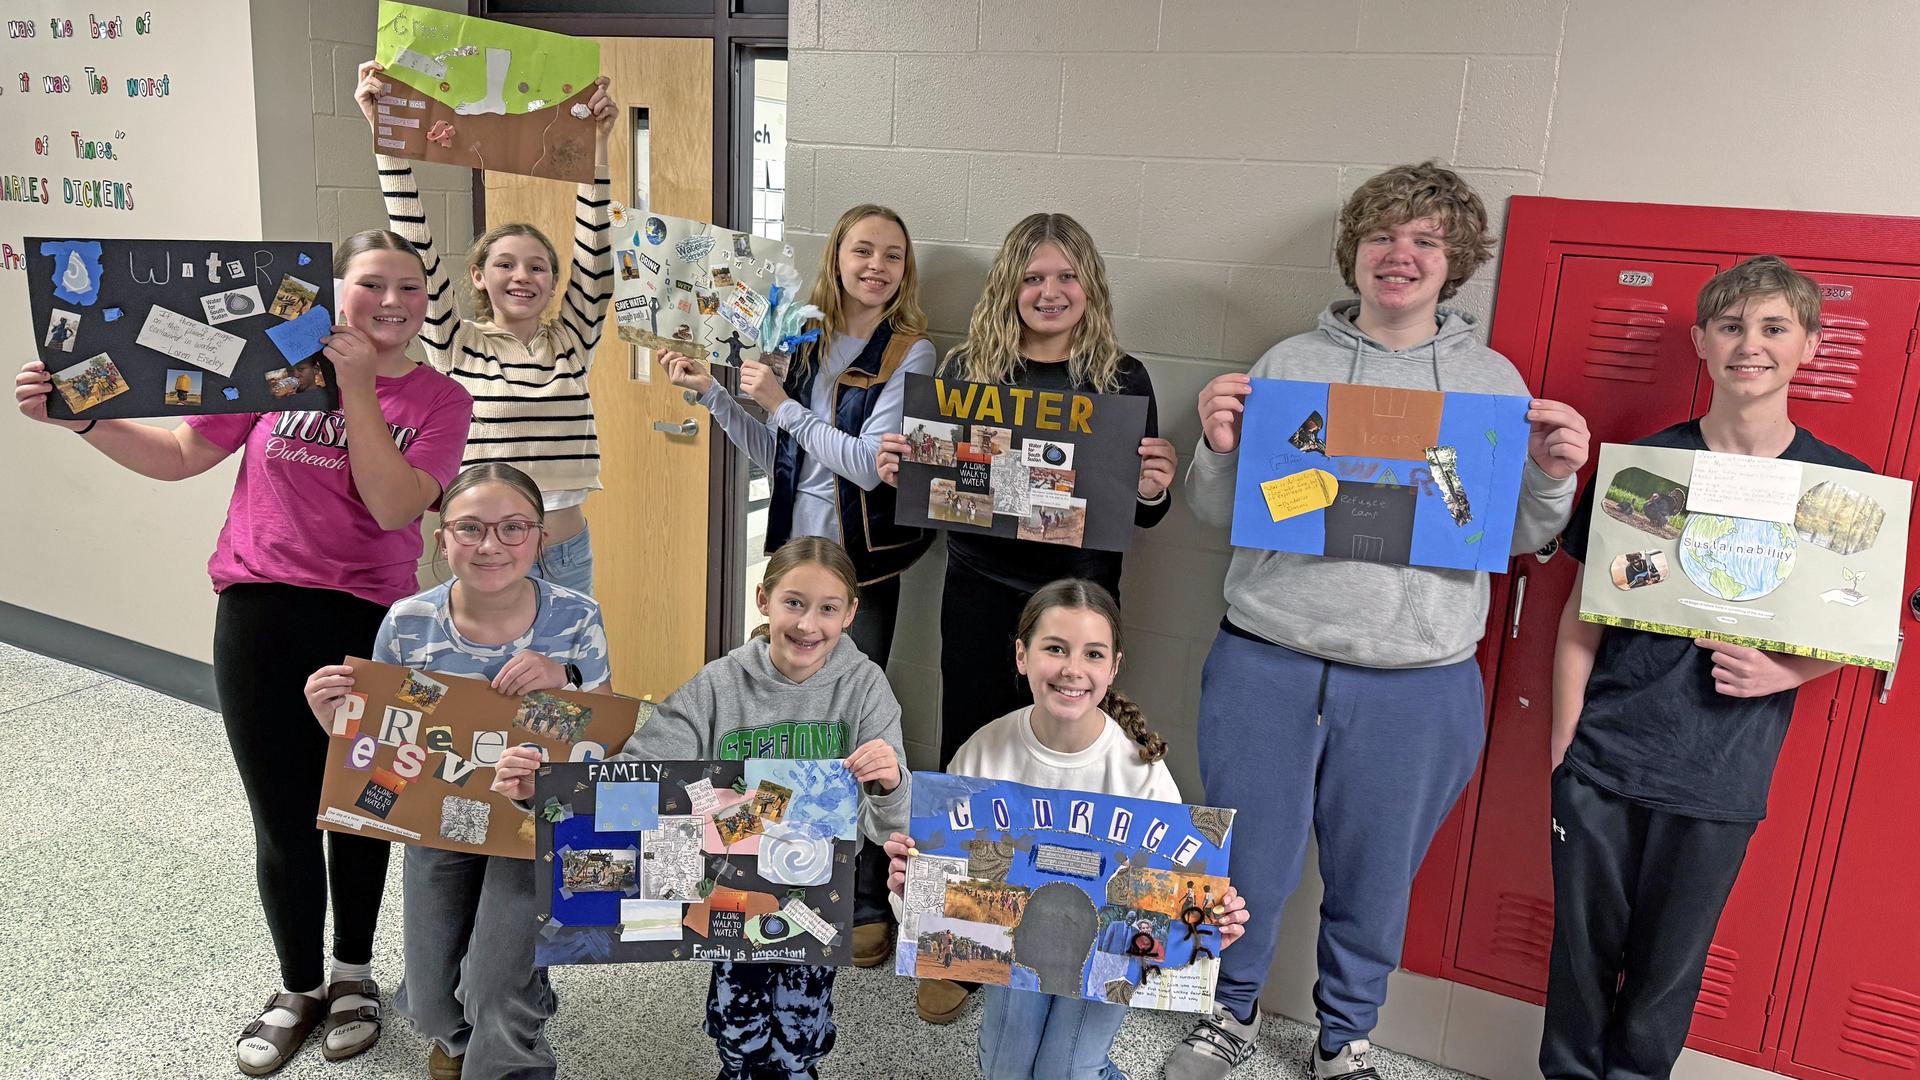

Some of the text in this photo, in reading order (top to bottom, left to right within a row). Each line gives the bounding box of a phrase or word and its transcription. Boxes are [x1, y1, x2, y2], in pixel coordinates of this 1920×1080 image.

[8, 12, 151, 39] was the best of
[19, 67, 170, 97] it was The worst
[35, 135, 48, 155] of
[63, 177, 134, 210] DICKENS
[640, 255, 660, 274] DRINK
[1621, 274, 1647, 284] 2379
[616, 296, 646, 311] SAVE WATER
[212, 313, 228, 321] Sudan
[934, 378, 1094, 434] WATER
[265, 437, 347, 470] Outreach
[960, 469, 979, 478] WALK
[969, 463, 986, 471] LONG
[961, 477, 985, 487] WATER
[1683, 537, 1792, 562] Sustainability
[588, 763, 664, 782] FAMILY
[366, 789, 392, 806] WALK TO
[378, 787, 394, 798] LONG
[364, 796, 386, 811] WATER
[953, 799, 1196, 863] COURAGE
[722, 912, 739, 920] LONG
[712, 920, 732, 929] WALK
[714, 929, 738, 937] WATER
[692, 944, 806, 960] Family is important
